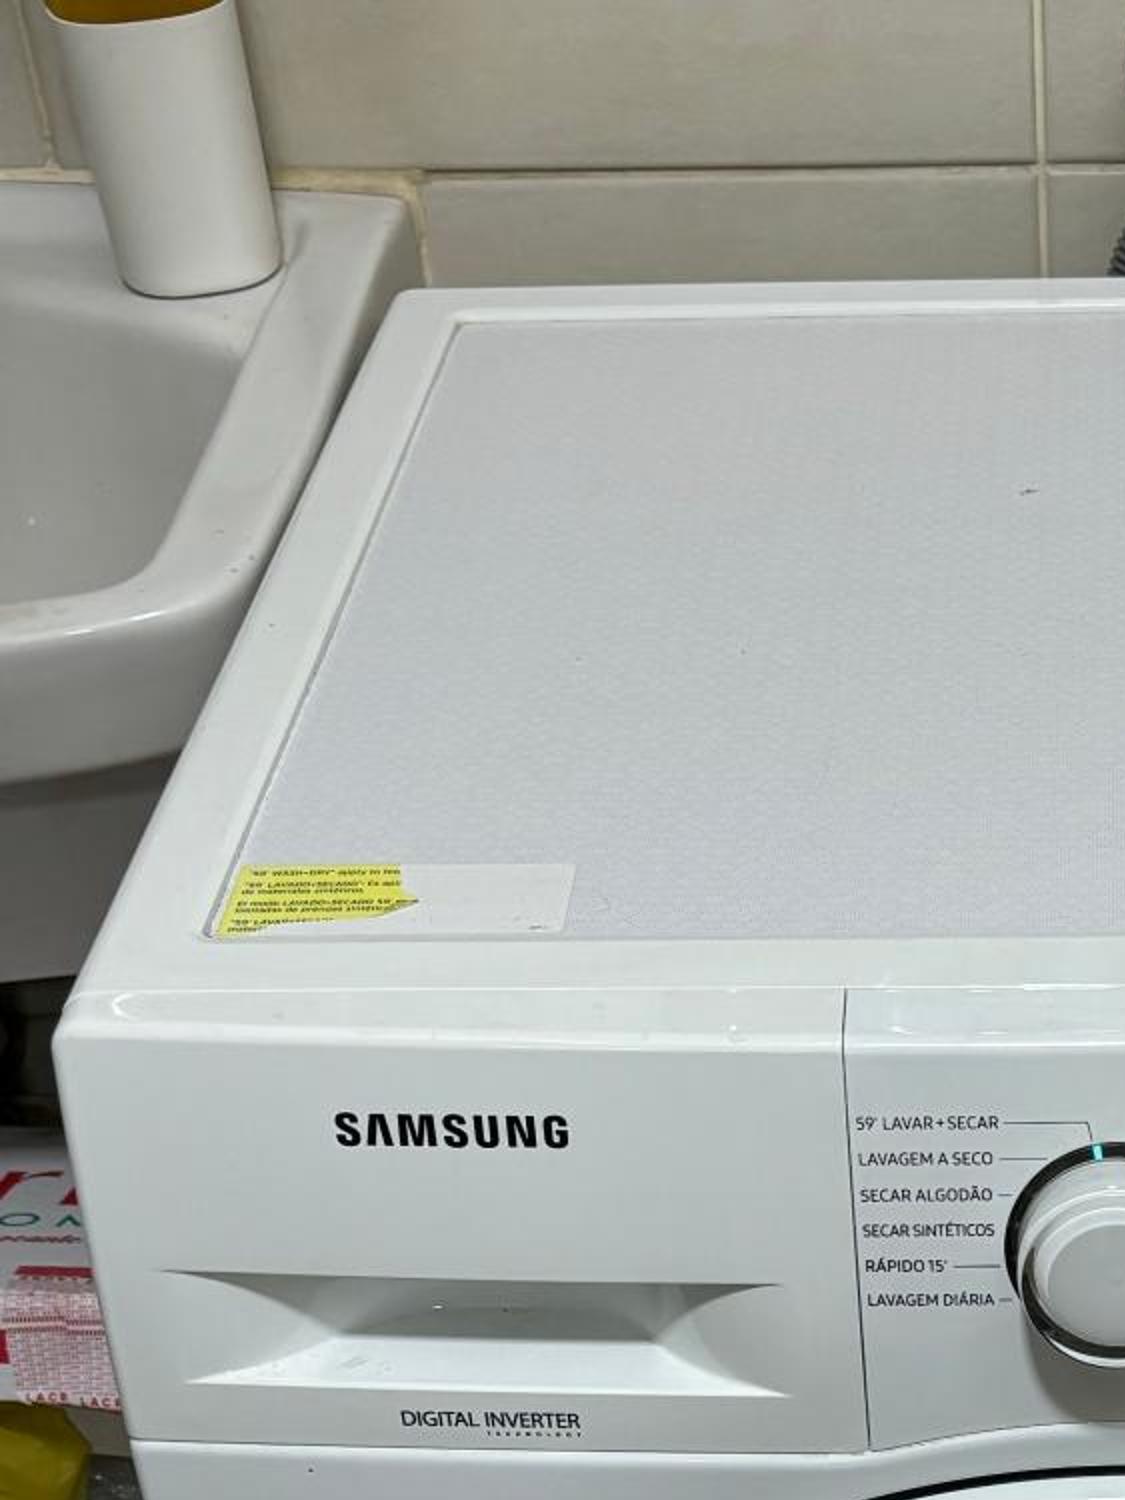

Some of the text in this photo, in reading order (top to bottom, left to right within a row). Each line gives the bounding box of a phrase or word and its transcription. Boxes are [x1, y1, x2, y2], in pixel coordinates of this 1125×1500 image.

[334, 1112, 570, 1149] SAMSUNG
[858, 1151, 993, 1167] LAVAGEM A SECO
[860, 1185, 993, 1203] SECAR ALGODÃO
[862, 1219, 995, 1238] SECAR SINTÉTICOS
[865, 1258, 925, 1272] RÁPIDO
[867, 1290, 995, 1307] LAVAGEM DIÁRIA
[400, 1410, 581, 1429] DIGITAL INVERTER
